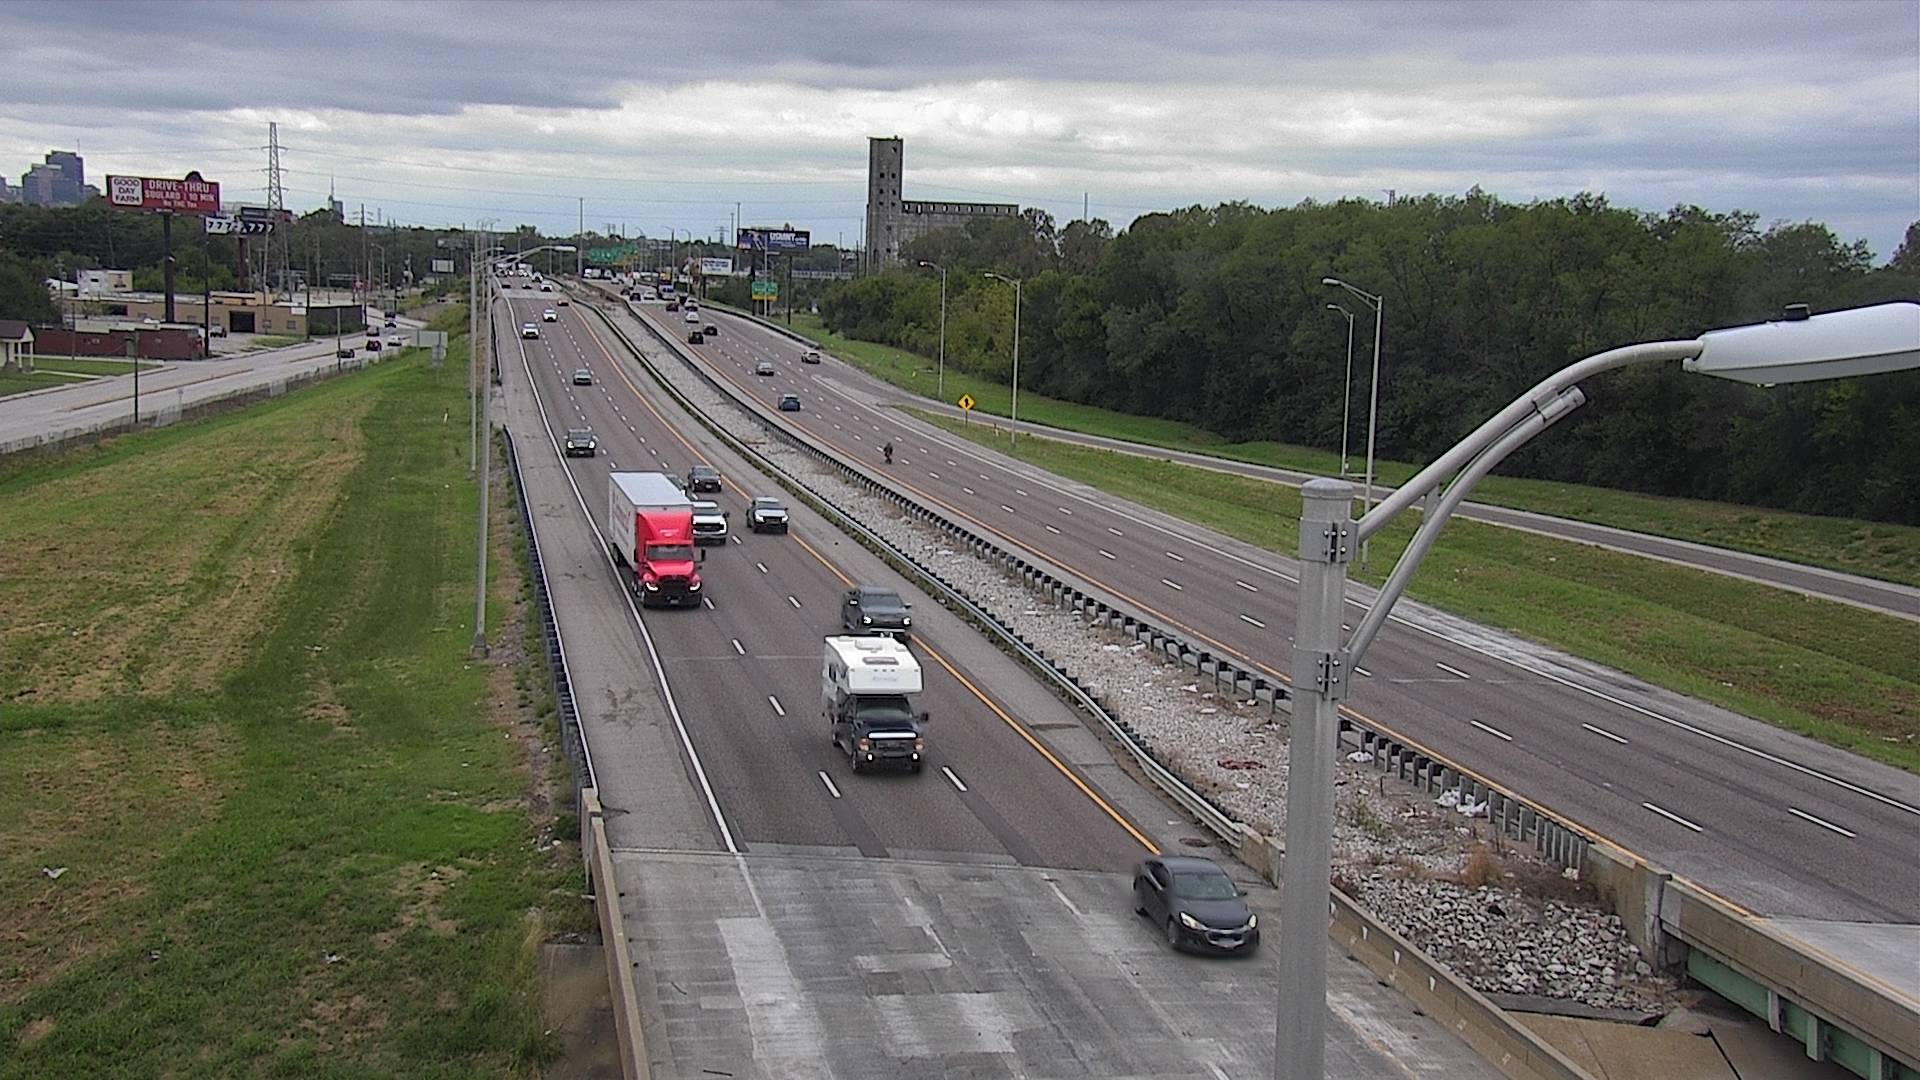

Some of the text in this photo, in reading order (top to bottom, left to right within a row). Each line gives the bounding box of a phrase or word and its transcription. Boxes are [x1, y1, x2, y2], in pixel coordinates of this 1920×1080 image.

[114, 178, 139, 186] GOOD
[149, 180, 210, 193] DRIVE-THRU
[115, 194, 140, 202] FARM
[144, 190, 181, 200] SOULARD
[189, 193, 198, 201] 10
